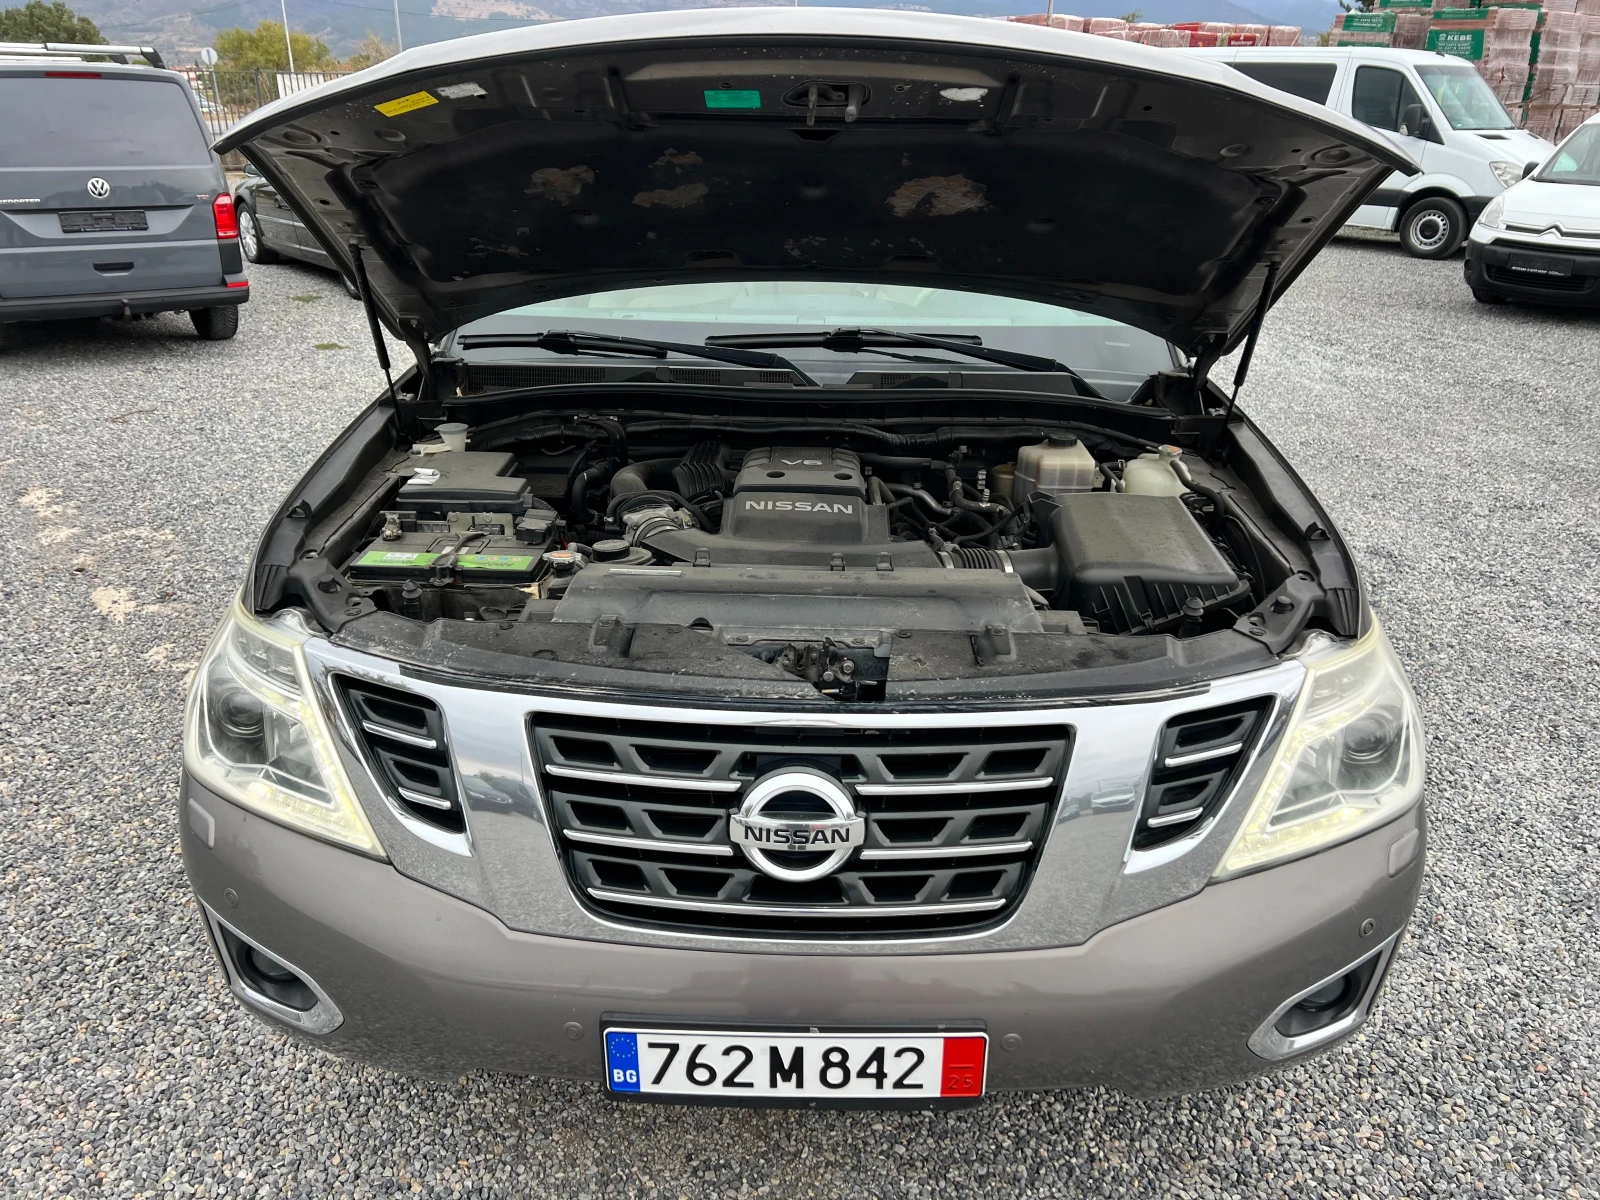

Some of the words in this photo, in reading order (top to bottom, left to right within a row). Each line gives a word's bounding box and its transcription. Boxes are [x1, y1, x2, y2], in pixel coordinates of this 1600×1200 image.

[745, 501, 853, 514] NISSAN
[744, 825, 850, 845] NISSAN
[613, 1067, 638, 1084] BG
[948, 1074, 974, 1090] 25
